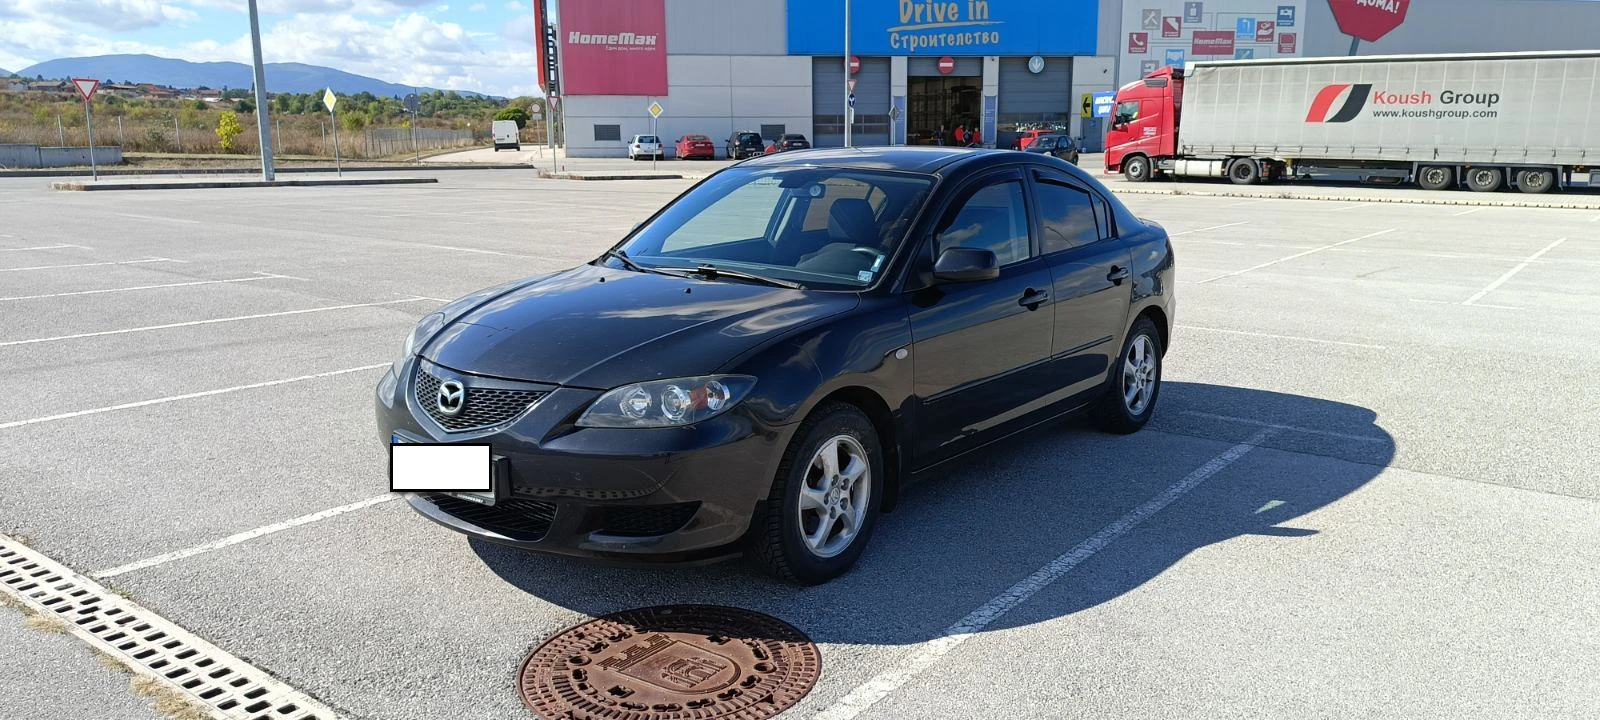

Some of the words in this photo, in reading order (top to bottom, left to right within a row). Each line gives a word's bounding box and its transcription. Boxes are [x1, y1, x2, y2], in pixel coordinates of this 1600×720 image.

[899, 0, 959, 24] Drive
[967, 0, 989, 20] in
[569, 31, 657, 45] HomeMax
[890, 31, 999, 52] Строителство
[1373, 90, 1432, 104] Koush
[1440, 90, 1500, 108] Group
[1372, 109, 1498, 119] www.koushgroup.com
